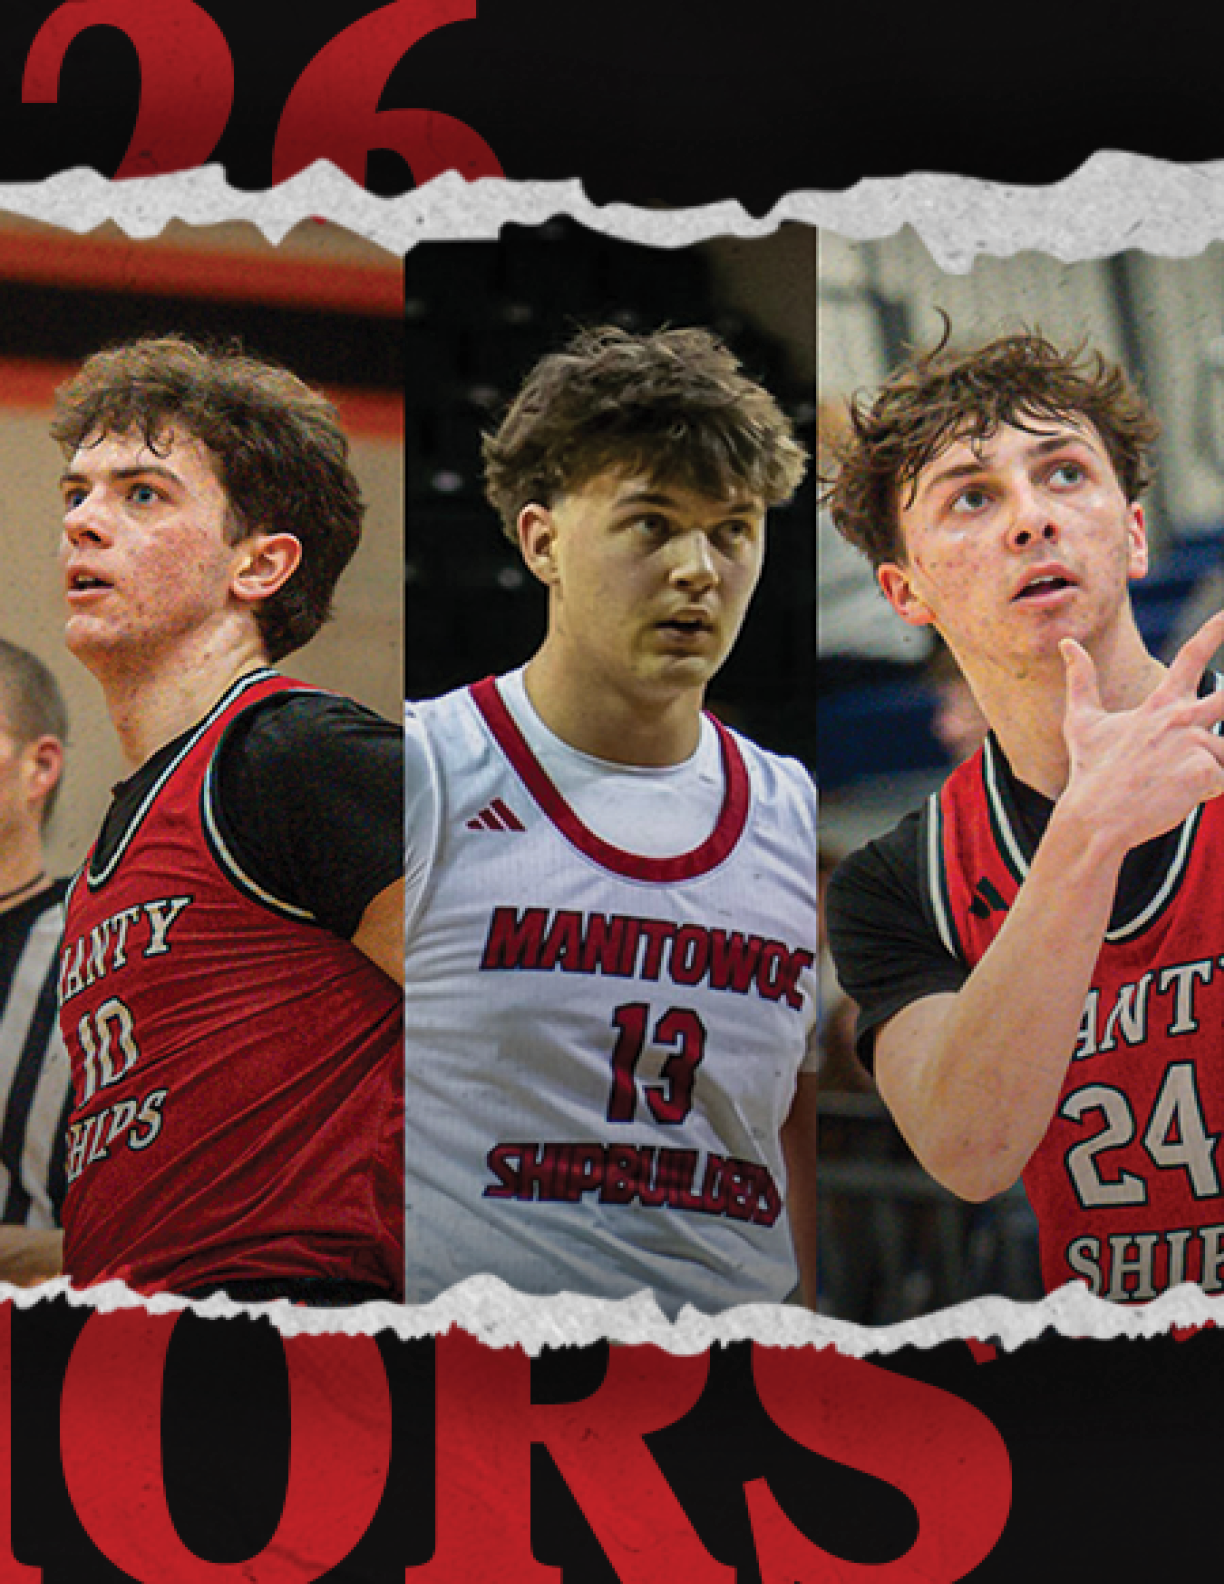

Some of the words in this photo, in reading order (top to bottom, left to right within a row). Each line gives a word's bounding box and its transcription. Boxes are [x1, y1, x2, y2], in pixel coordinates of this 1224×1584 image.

[59, 894, 194, 1007] ANTY
[479, 906, 815, 1014] MANITOWOC
[77, 994, 141, 1110] 10
[605, 1001, 707, 1125] 13
[1071, 953, 1224, 1062] ANT
[65, 1087, 169, 1185] HIPS
[1057, 1059, 1223, 1209] 24
